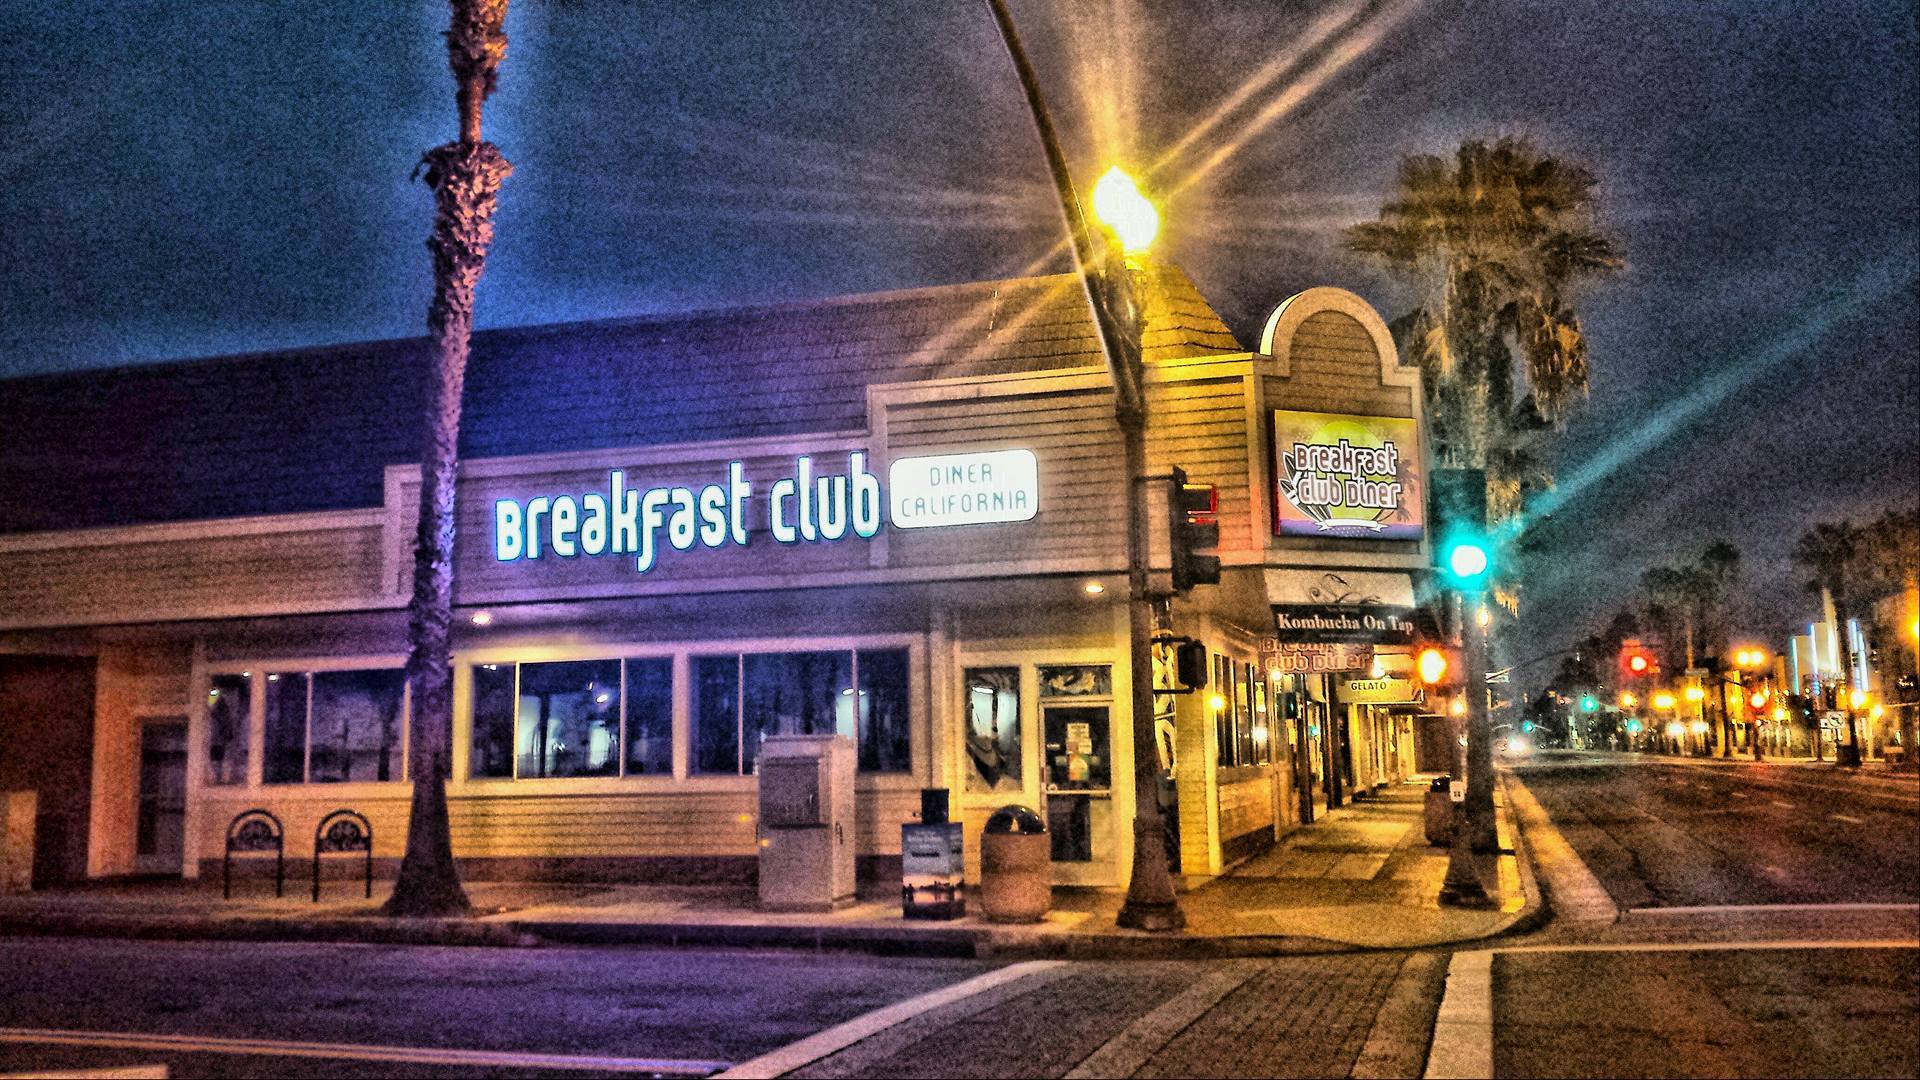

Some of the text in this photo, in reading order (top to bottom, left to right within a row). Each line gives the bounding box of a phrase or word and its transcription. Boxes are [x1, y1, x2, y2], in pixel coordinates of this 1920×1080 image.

[1293, 439, 1398, 478] Breakfast
[929, 463, 993, 487] DINER
[496, 451, 881, 573] Breakfast club
[901, 489, 1028, 518] CALIFORNIA
[1277, 612, 1414, 635] Kombucha On Tap
[1350, 681, 1387, 691] GELATO
